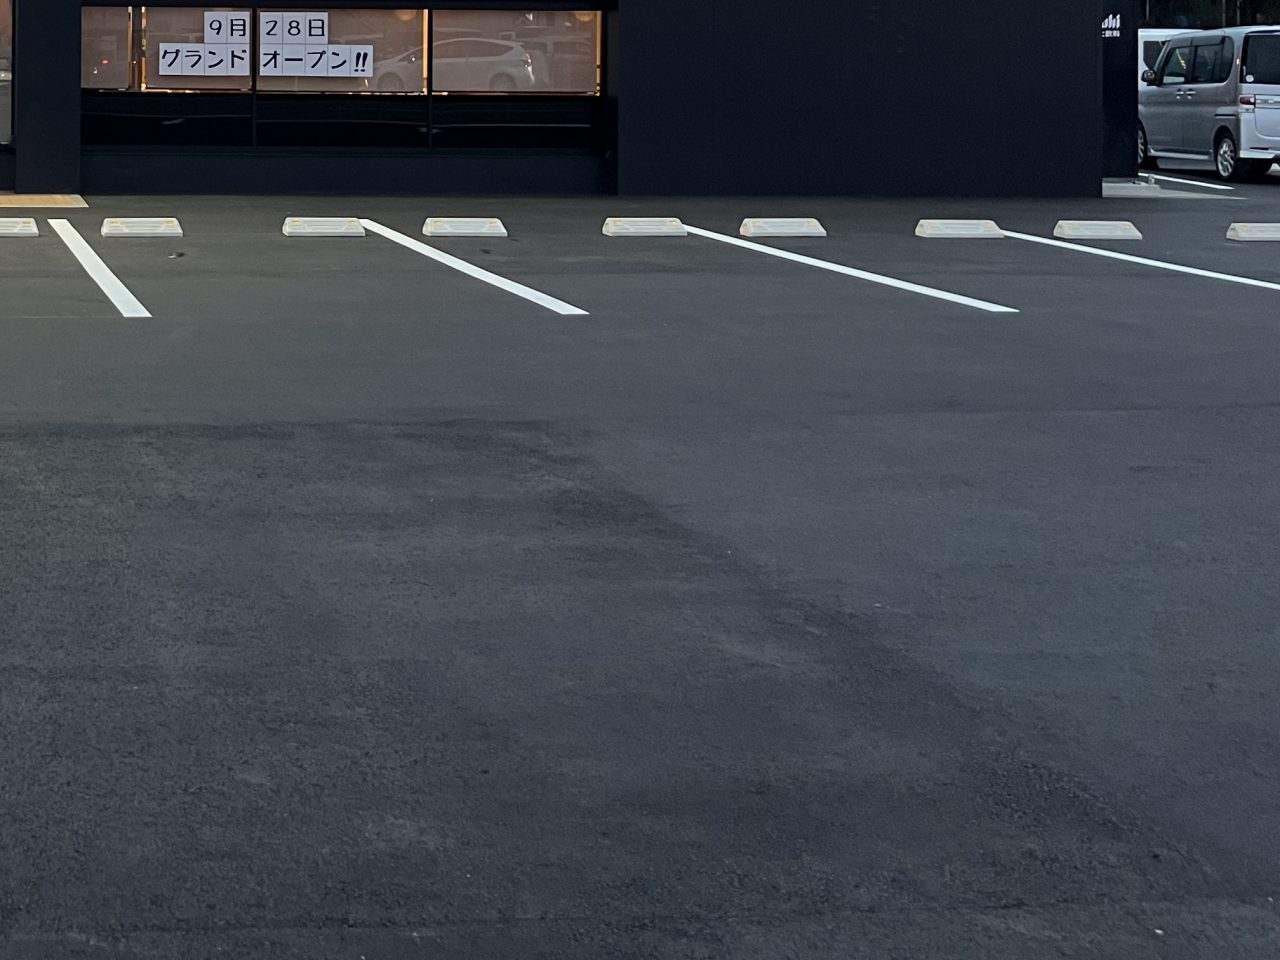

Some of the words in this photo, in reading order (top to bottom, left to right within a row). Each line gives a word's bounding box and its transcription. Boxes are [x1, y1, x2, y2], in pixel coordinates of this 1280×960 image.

[209, 18, 247, 37] 9月
[265, 19, 326, 37] 28日
[161, 48, 248, 69] グランド
